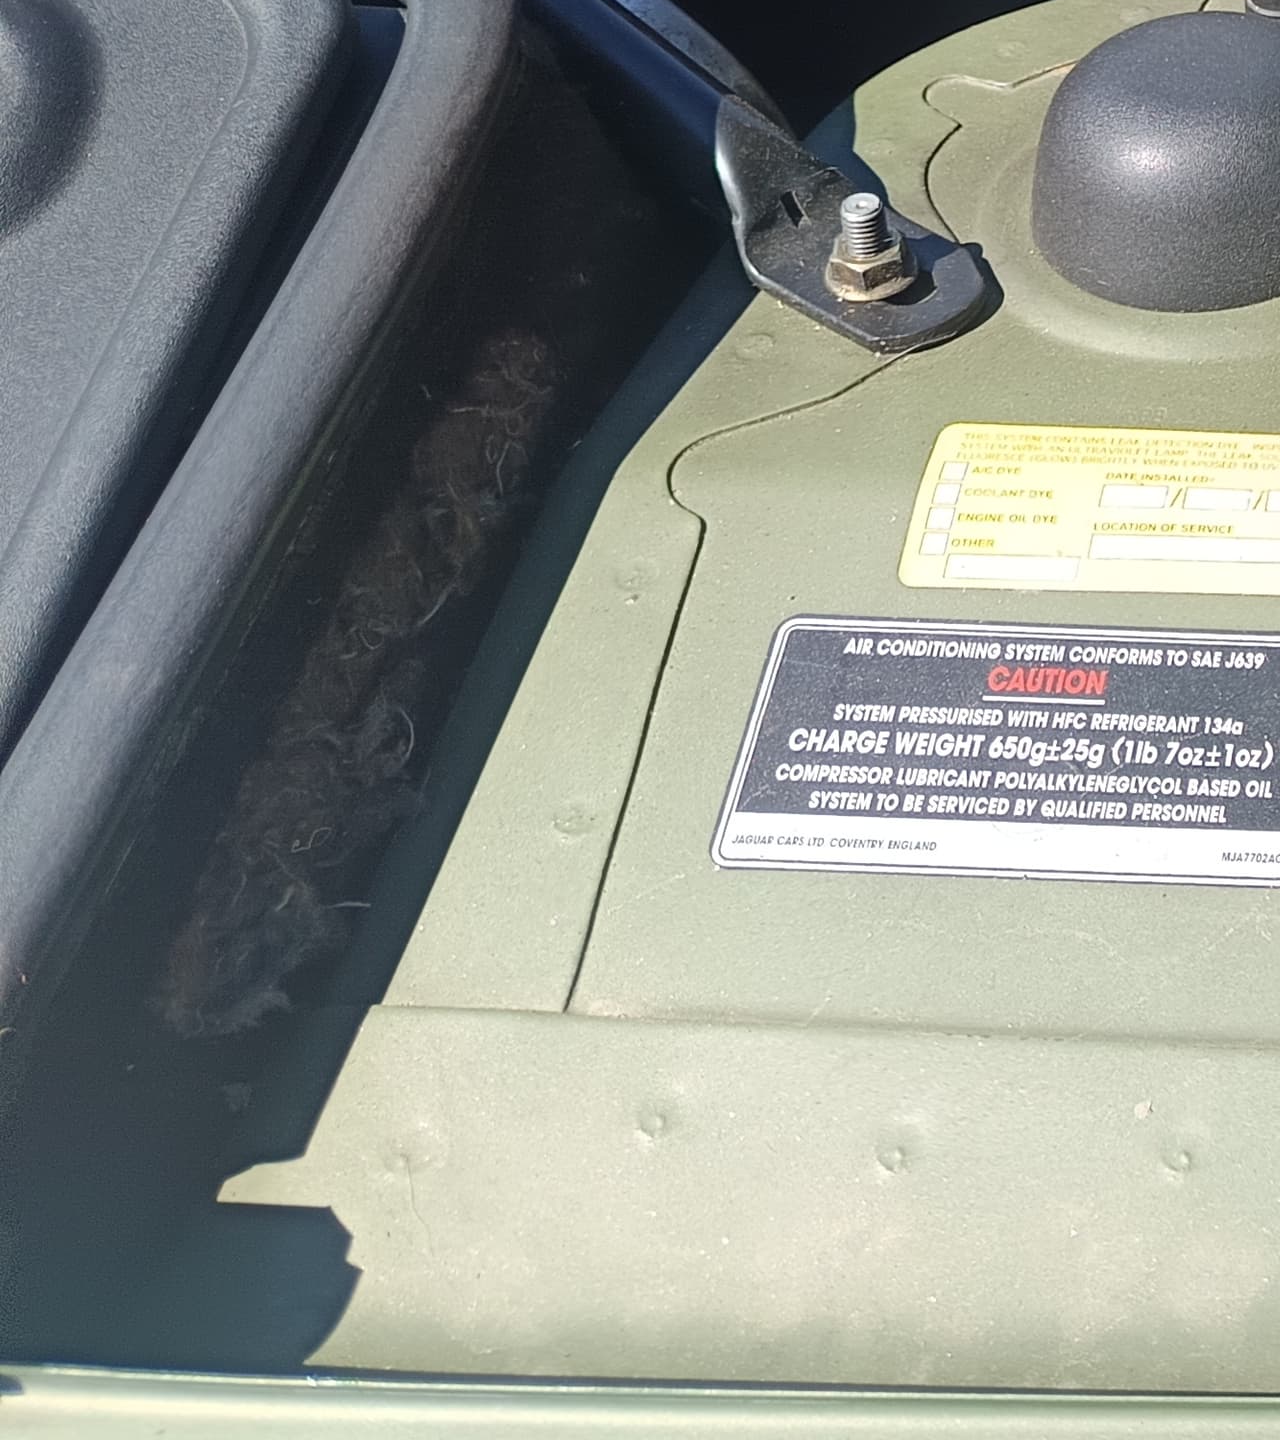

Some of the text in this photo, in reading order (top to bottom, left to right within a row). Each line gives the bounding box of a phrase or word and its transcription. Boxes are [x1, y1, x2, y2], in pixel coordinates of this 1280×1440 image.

[996, 466, 1022, 475] DYE
[1105, 472, 1138, 481] DATE
[964, 488, 1054, 499] COOLANT DYE
[957, 513, 1058, 524] ENGINE OIL DYE
[1093, 523, 1234, 534] LOCATION OF SERVICE
[951, 538, 995, 548] OTHER
[843, 638, 1265, 670] AIR CONDITIONING SYSTEM CONFORMS TO SAE J639
[987, 665, 1109, 695] CAUTION
[833, 704, 1244, 735] SYSTEM PRESSURISED WITH HFC REFRIGERANT 134a
[788, 727, 1274, 770] CHARGE WEIGHT 650g±25g (1lb 7oz±1oz)
[775, 763, 1273, 799] COMPRESSOR LUBRICANT POLYALKYLENEGLYCOL BASED OIL
[808, 790, 1227, 823] SYSTEM TO BE SERVICED BY QUALIFIED PERSONNEL
[732, 834, 774, 845] JAGUAR
[777, 836, 805, 846] CARS
[888, 840, 937, 851] ENGLAND
